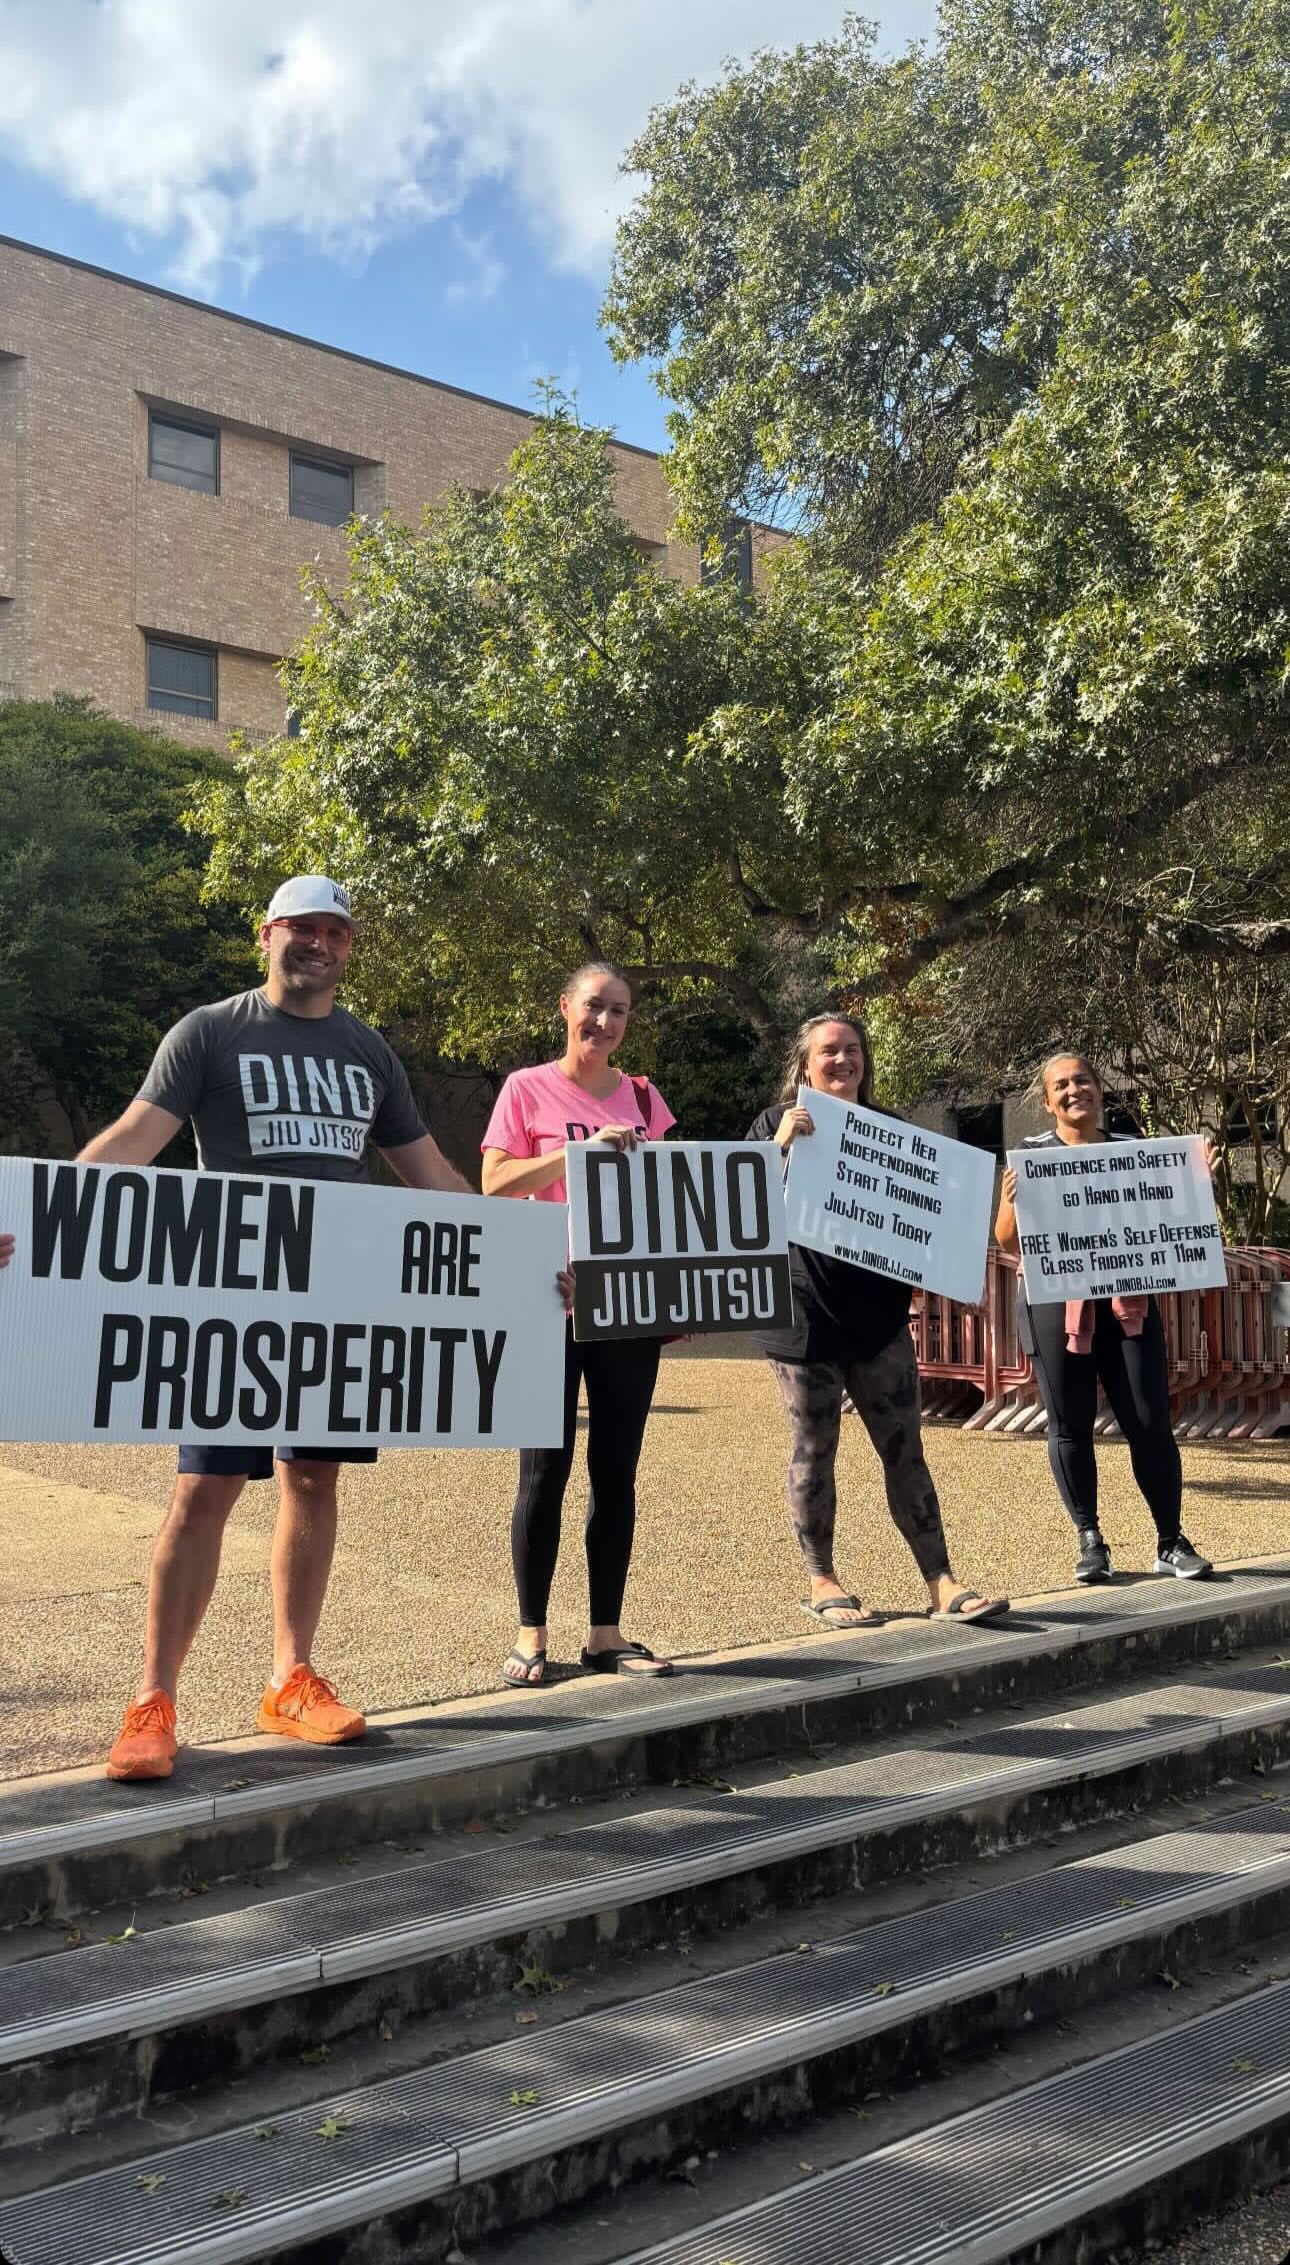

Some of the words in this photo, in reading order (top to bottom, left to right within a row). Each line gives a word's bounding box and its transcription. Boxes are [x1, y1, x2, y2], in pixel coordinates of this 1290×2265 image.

[238, 1053, 376, 1121] DINO
[262, 1119, 301, 1147] JIU
[308, 1120, 365, 1153] JITSU
[839, 1132, 940, 1186] INDEPENDANCE
[845, 1110, 905, 1150] PROTECT
[911, 1135, 937, 1163] HER
[836, 1160, 880, 1193] START
[885, 1175, 942, 1215] TRAINING
[1025, 1158, 1107, 1179] CONFIDENCE
[1109, 1155, 1135, 1172] AND
[1137, 1150, 1187, 1169] SAFETY
[585, 1150, 770, 1255] DINO
[1062, 1193, 1080, 1207] GO
[1084, 1185, 1120, 1205] HAND
[1123, 1188, 1136, 1203] IN
[1139, 1181, 1173, 1201] HAND
[31, 1163, 315, 1293] WOMEN
[400, 1220, 483, 1297] ARE
[892, 1213, 933, 1246] TODAY
[1021, 1233, 1051, 1255] FREE
[1057, 1227, 1118, 1252] WOMEN'S
[1124, 1226, 1157, 1247] SELF
[1158, 1223, 1220, 1242] DEFENSE
[1040, 1256, 1084, 1276] CLASS
[1091, 1251, 1144, 1272] FRIDAYS
[1151, 1250, 1167, 1266] AT
[593, 1270, 657, 1328] JIU
[669, 1266, 776, 1324] JITSU
[93, 1313, 507, 1434] PROSPERITY
